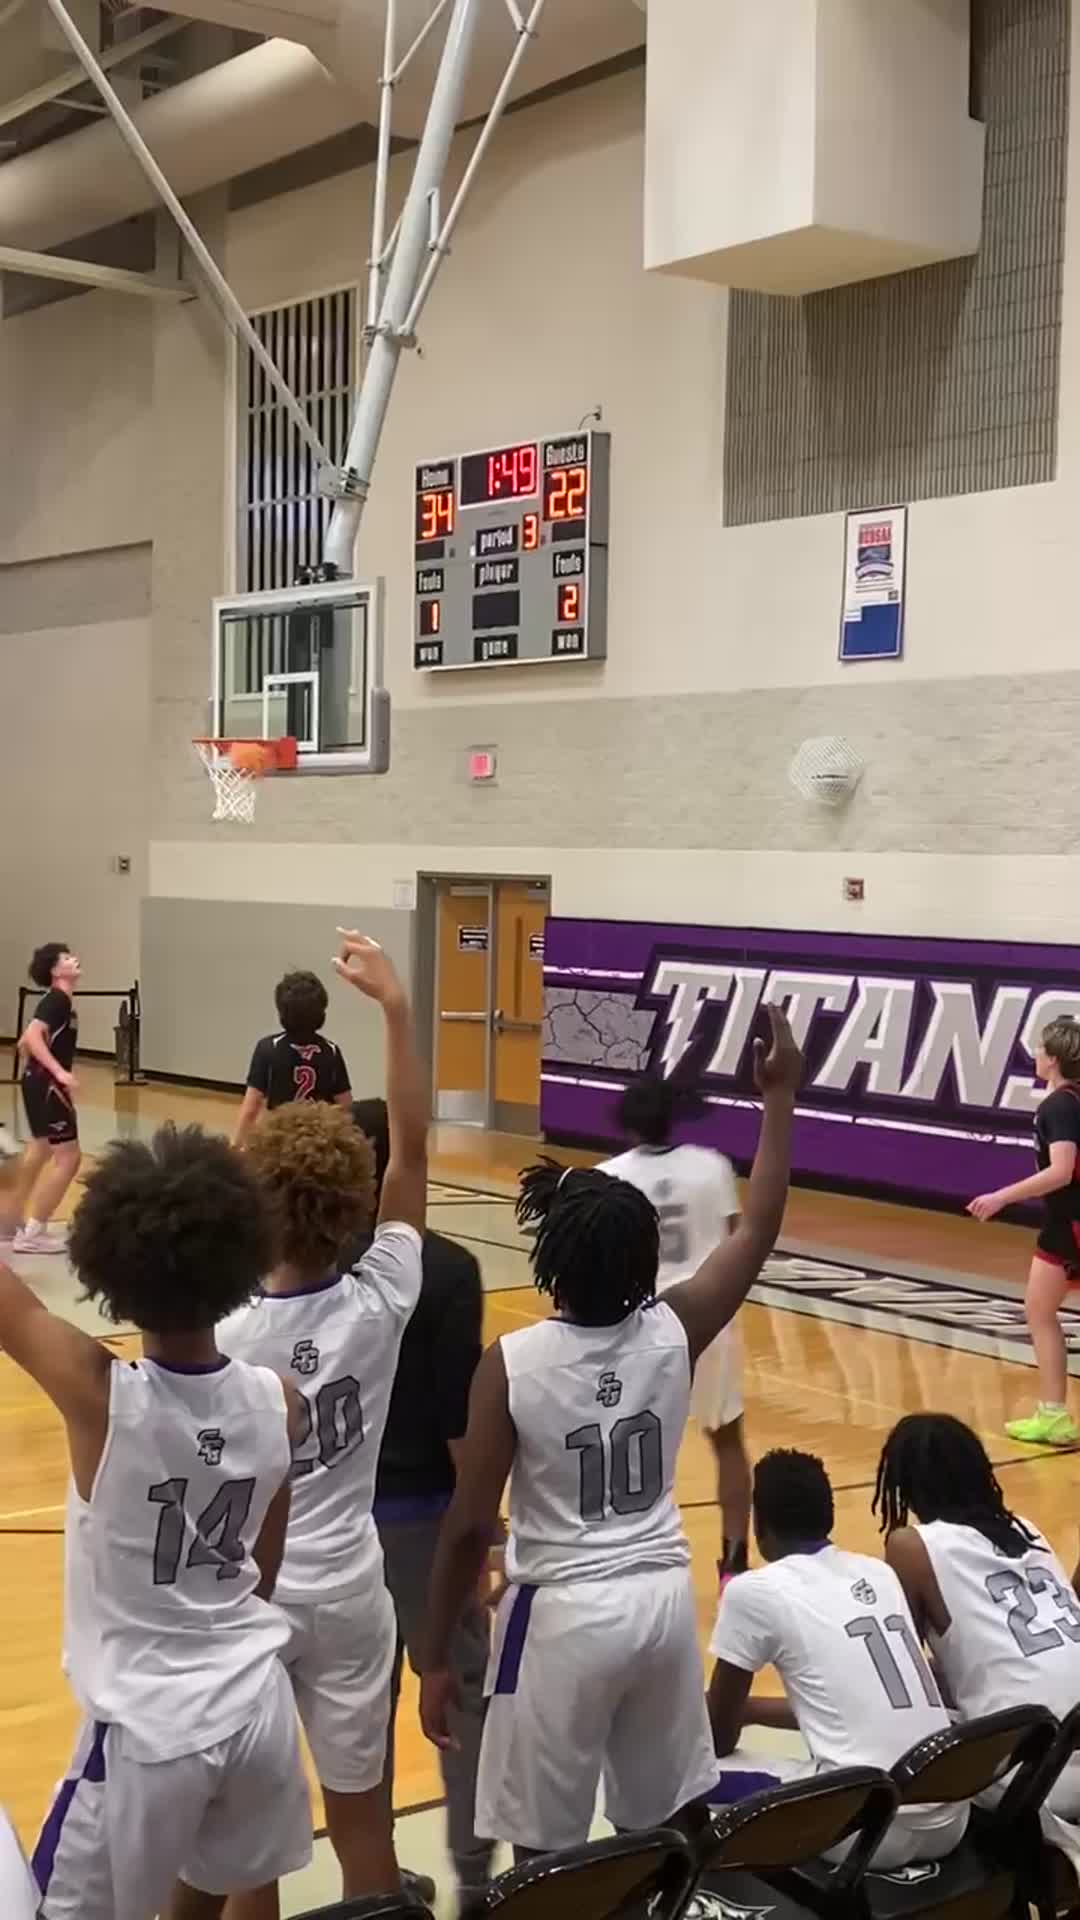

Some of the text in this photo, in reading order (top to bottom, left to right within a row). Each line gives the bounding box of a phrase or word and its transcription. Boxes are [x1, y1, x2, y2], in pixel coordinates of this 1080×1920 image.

[488, 446, 536, 496] 1:49
[549, 468, 585, 518] 22
[422, 493, 453, 538] 34
[524, 514, 538, 549] 3
[481, 526, 513, 553] period
[480, 563, 513, 585] player
[432, 603, 439, 630] 1
[563, 585, 577, 619] 2
[294, 1065, 317, 1104] 2
[565, 1409, 663, 1521] 10
[148, 1477, 256, 1584] 14
[985, 1566, 1080, 1657] 23
[844, 1614, 941, 1709] 11
